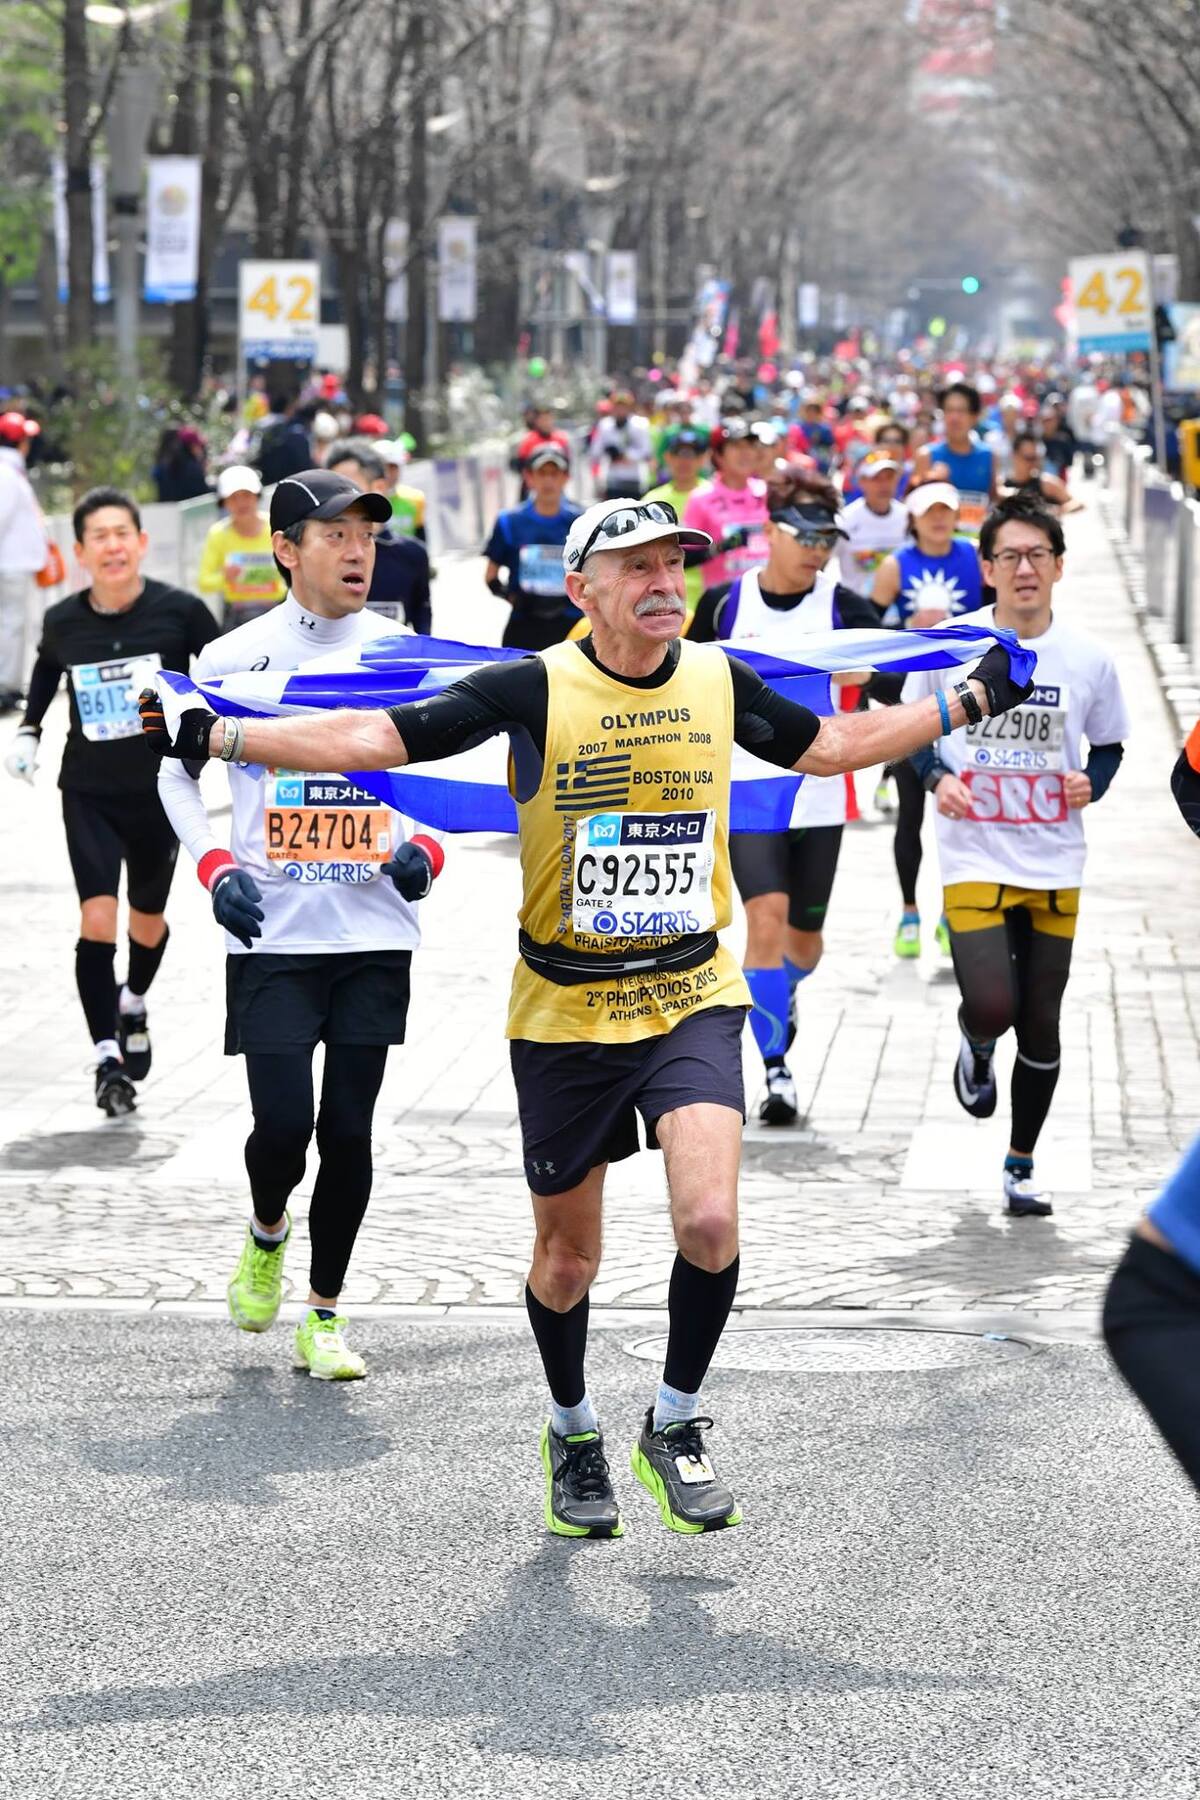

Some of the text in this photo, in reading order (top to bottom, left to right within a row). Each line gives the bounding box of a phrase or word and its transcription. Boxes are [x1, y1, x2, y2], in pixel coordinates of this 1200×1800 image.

[247, 275, 314, 321] 42
[1077, 268, 1146, 315] 42
[601, 707, 691, 730] OLYMPUS
[578, 732, 712, 756] 2007 MARATHON 2008
[633, 770, 714, 785] BOSTON USA
[661, 787, 694, 801] 2010
[269, 812, 372, 850] B24704
[627, 821, 700, 839] 東京メトロ
[557, 815, 576, 934] SPARTATHLON 2017
[577, 852, 696, 896] C92555
[576, 898, 613, 909] GATE 2
[693, 967, 718, 991] 2015
[609, 1005, 652, 1021] ATHENS
[661, 994, 703, 1014] SPARTA
